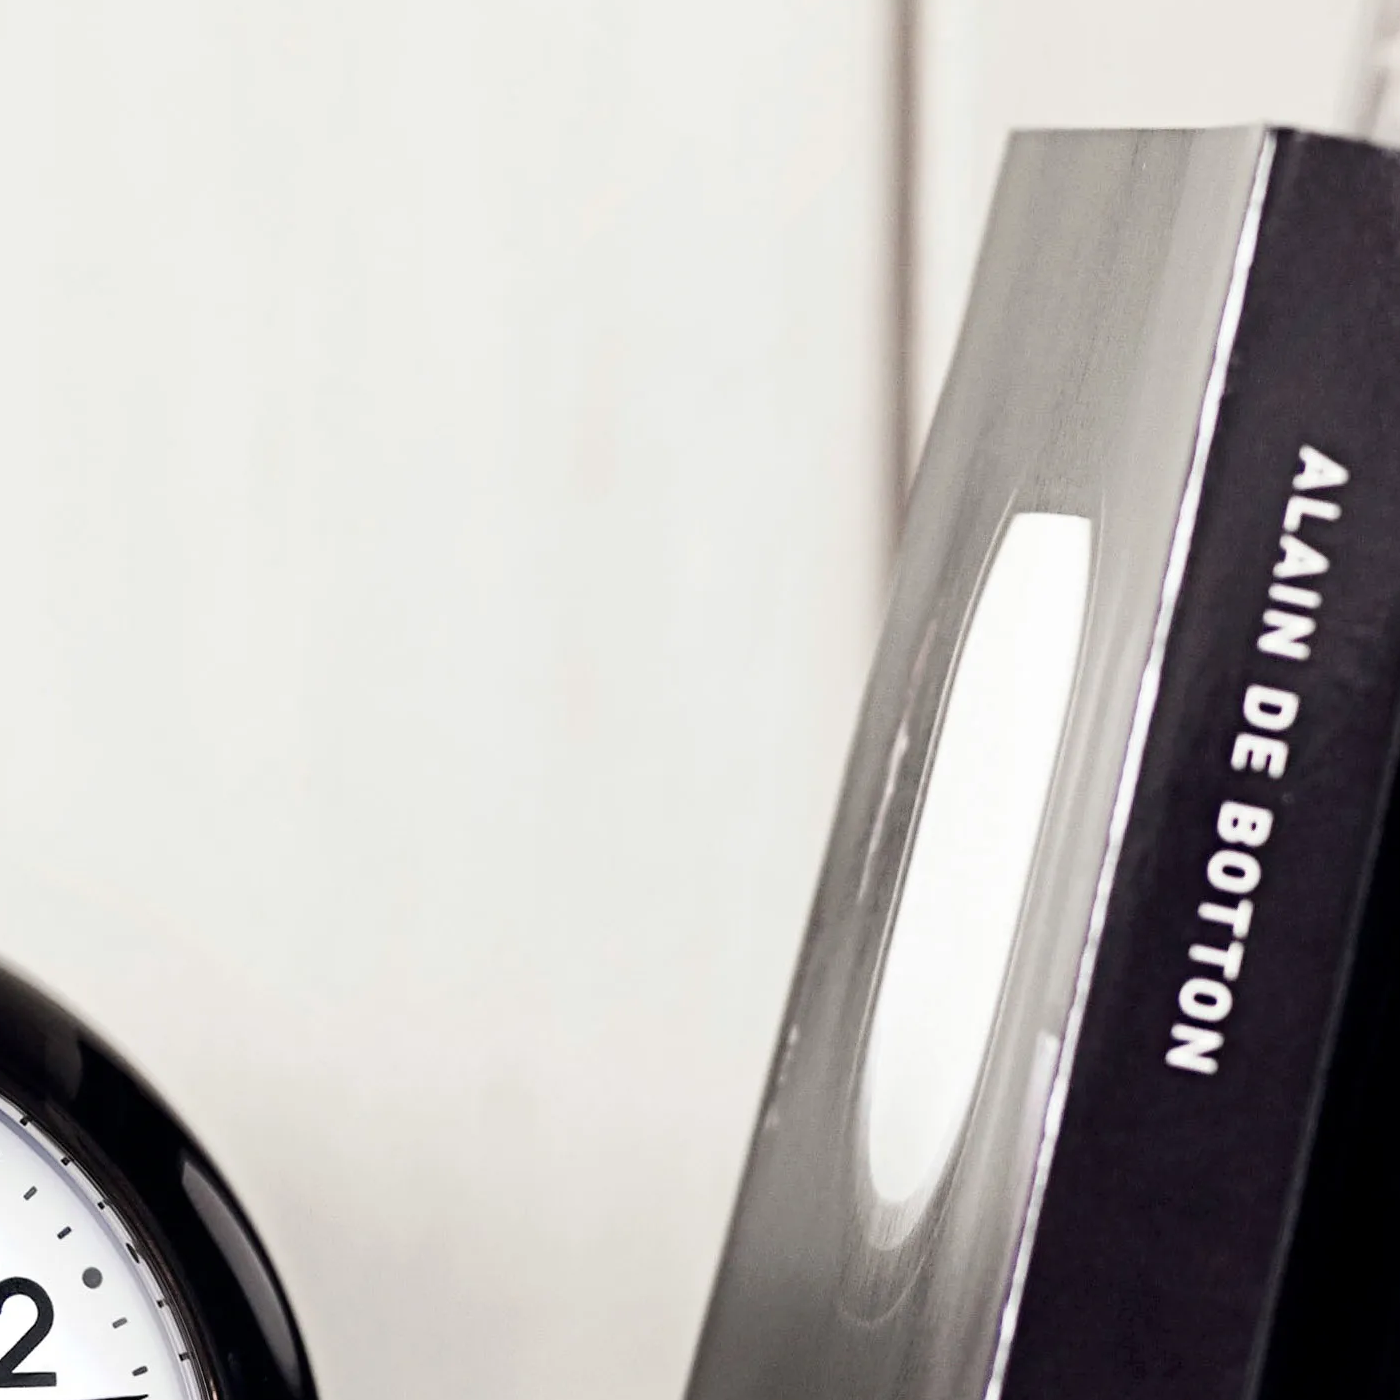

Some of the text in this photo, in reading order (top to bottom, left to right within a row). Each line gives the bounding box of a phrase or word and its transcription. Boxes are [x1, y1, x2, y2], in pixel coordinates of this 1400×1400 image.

[1165, 444, 1349, 1075] ALAIN DE BOTTON
